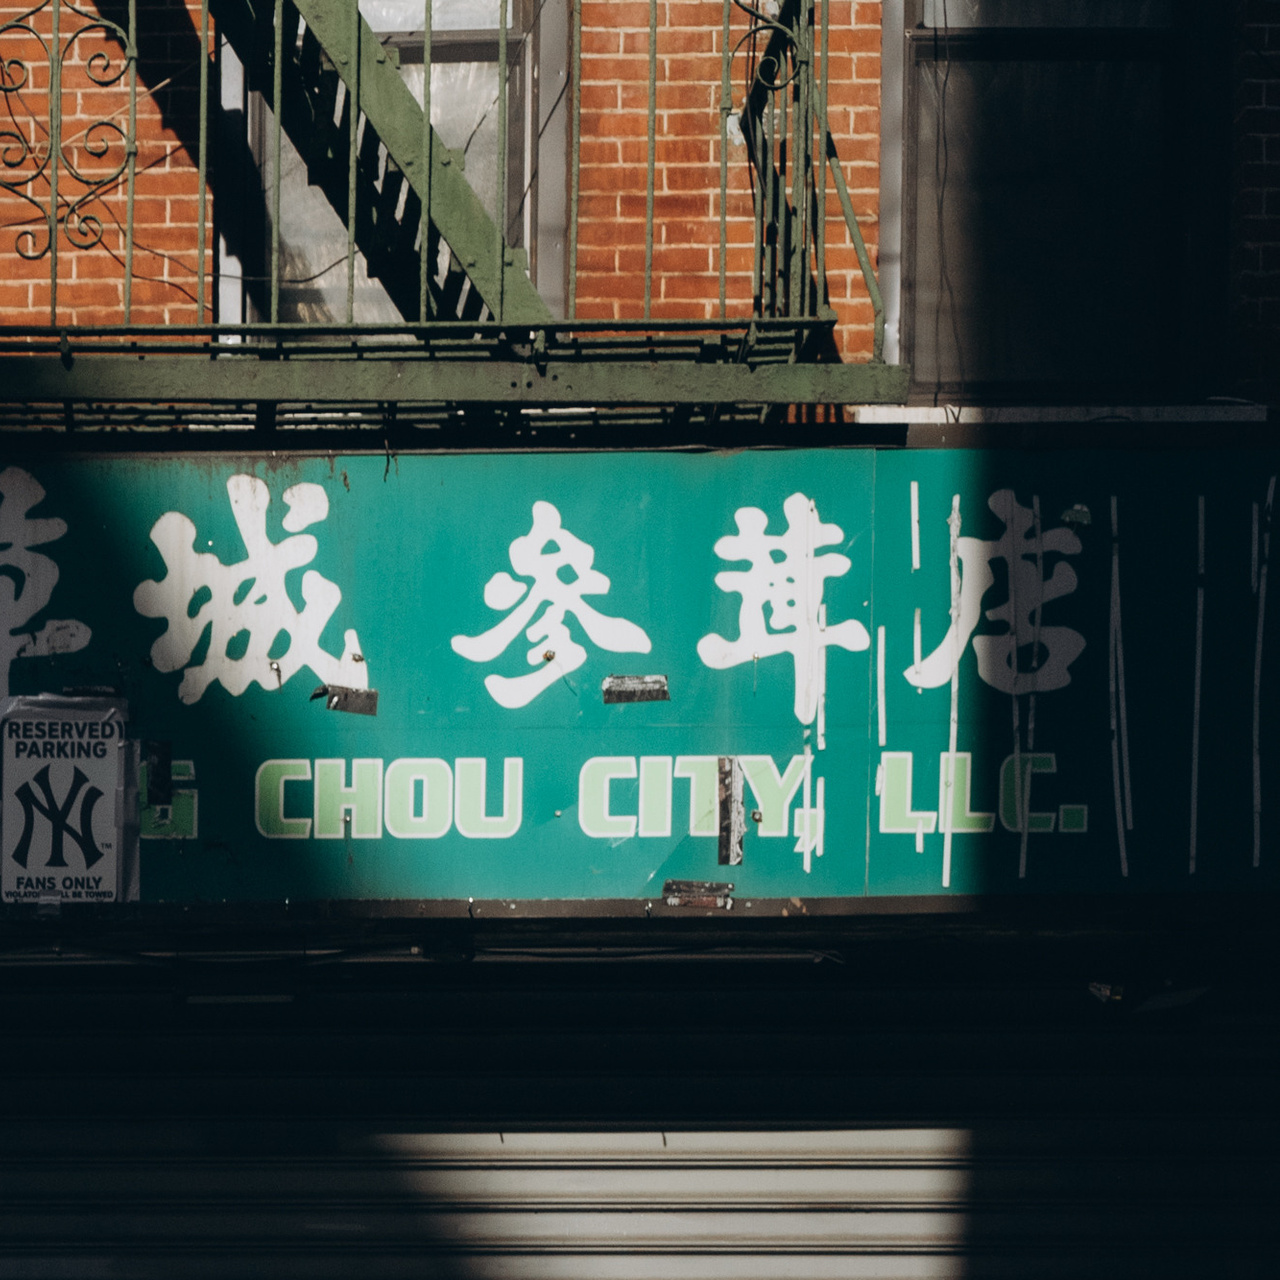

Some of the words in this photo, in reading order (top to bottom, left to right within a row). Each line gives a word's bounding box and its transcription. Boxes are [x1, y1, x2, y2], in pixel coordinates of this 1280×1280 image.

[7, 721, 116, 740] RESERVED
[14, 740, 108, 759] PARKING
[254, 757, 524, 840] CHOU
[877, 750, 1089, 835] LLC.
[16, 876, 57, 890] FANS
[61, 876, 103, 890] ONLY
[4, 890, 40, 899] VIOLATO
[71, 890, 83, 899] BE
[85, 890, 114, 899] TOWED
